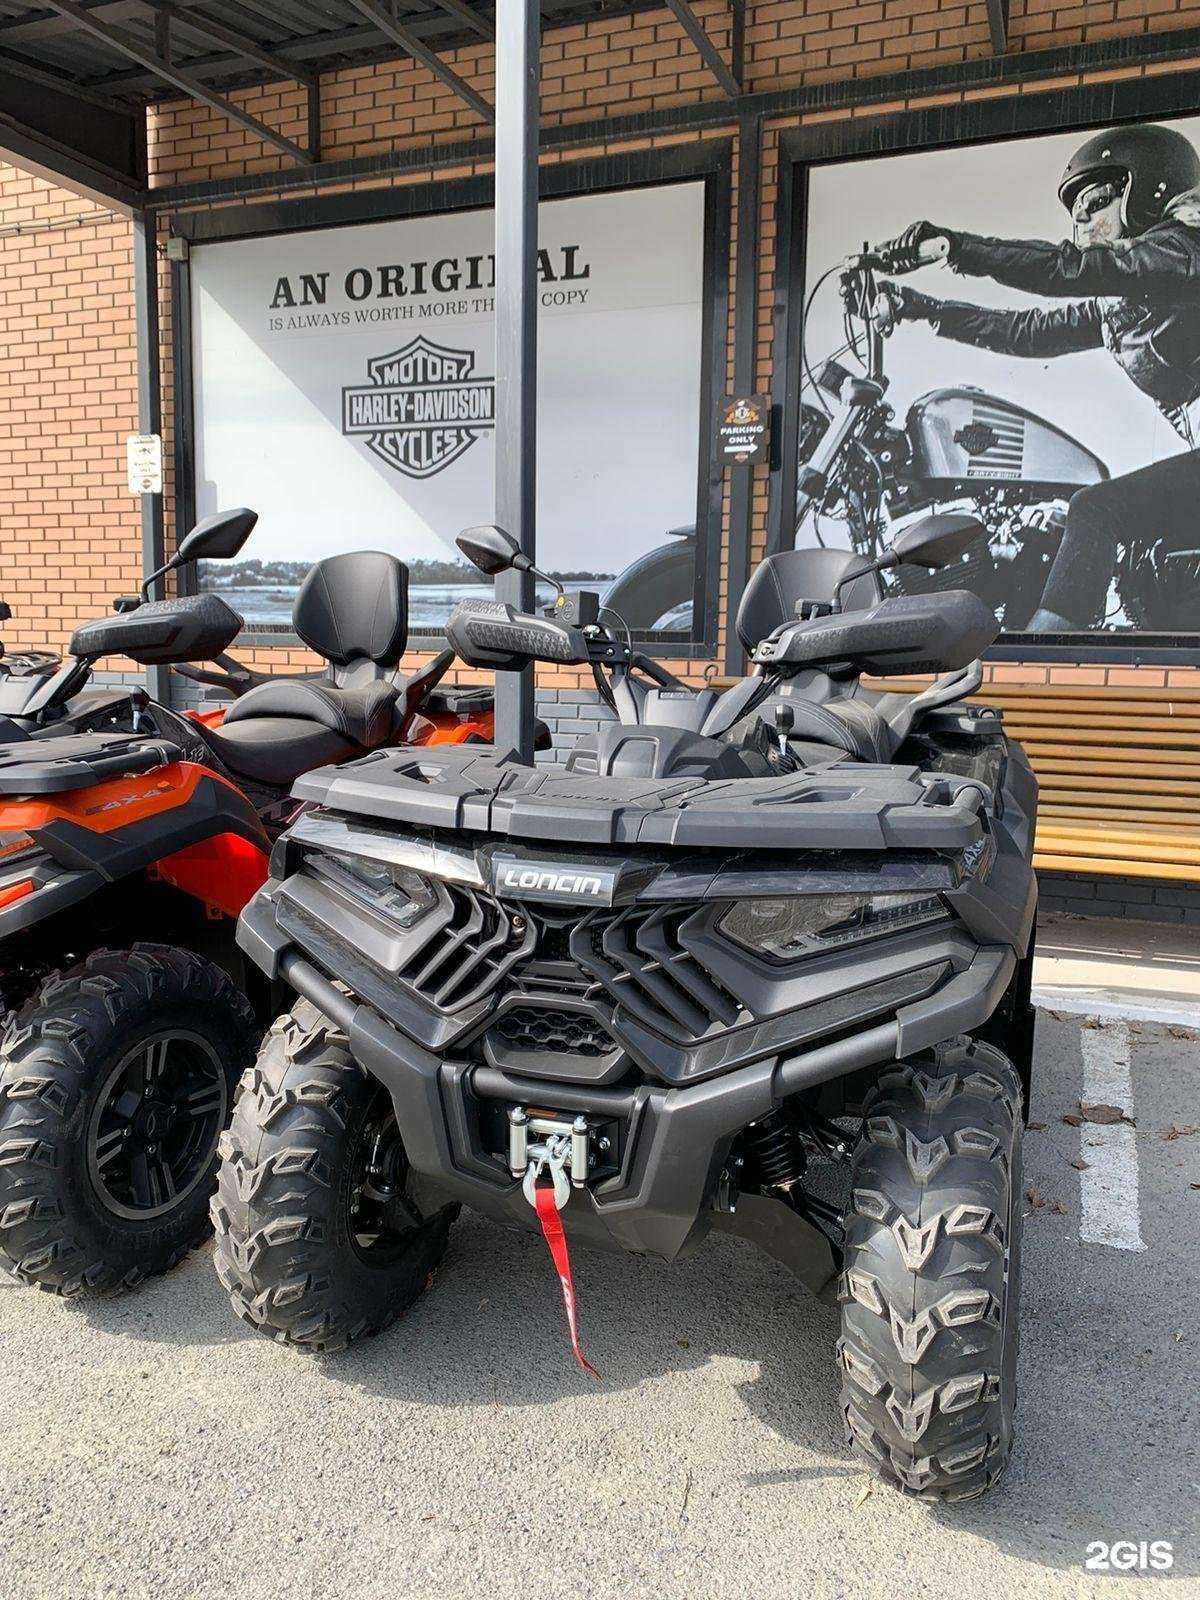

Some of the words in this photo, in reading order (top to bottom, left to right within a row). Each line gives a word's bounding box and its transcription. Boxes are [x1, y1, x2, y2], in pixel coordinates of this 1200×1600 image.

[269, 272, 330, 308] AN
[344, 244, 591, 301] ORIGIAL
[269, 318, 283, 331] IS
[287, 311, 351, 329] ALWAYS
[354, 303, 414, 323] WORTH
[418, 300, 468, 317] MORE
[541, 289, 589, 306] COPY
[383, 351, 459, 385] MOTOR
[352, 388, 491, 424] HARLEY-DAVIDSON
[720, 425, 764, 435] PARKING
[728, 435, 755, 444] ONLY
[383, 429, 458, 469] CYCLES
[504, 870, 602, 895] LONCIN
